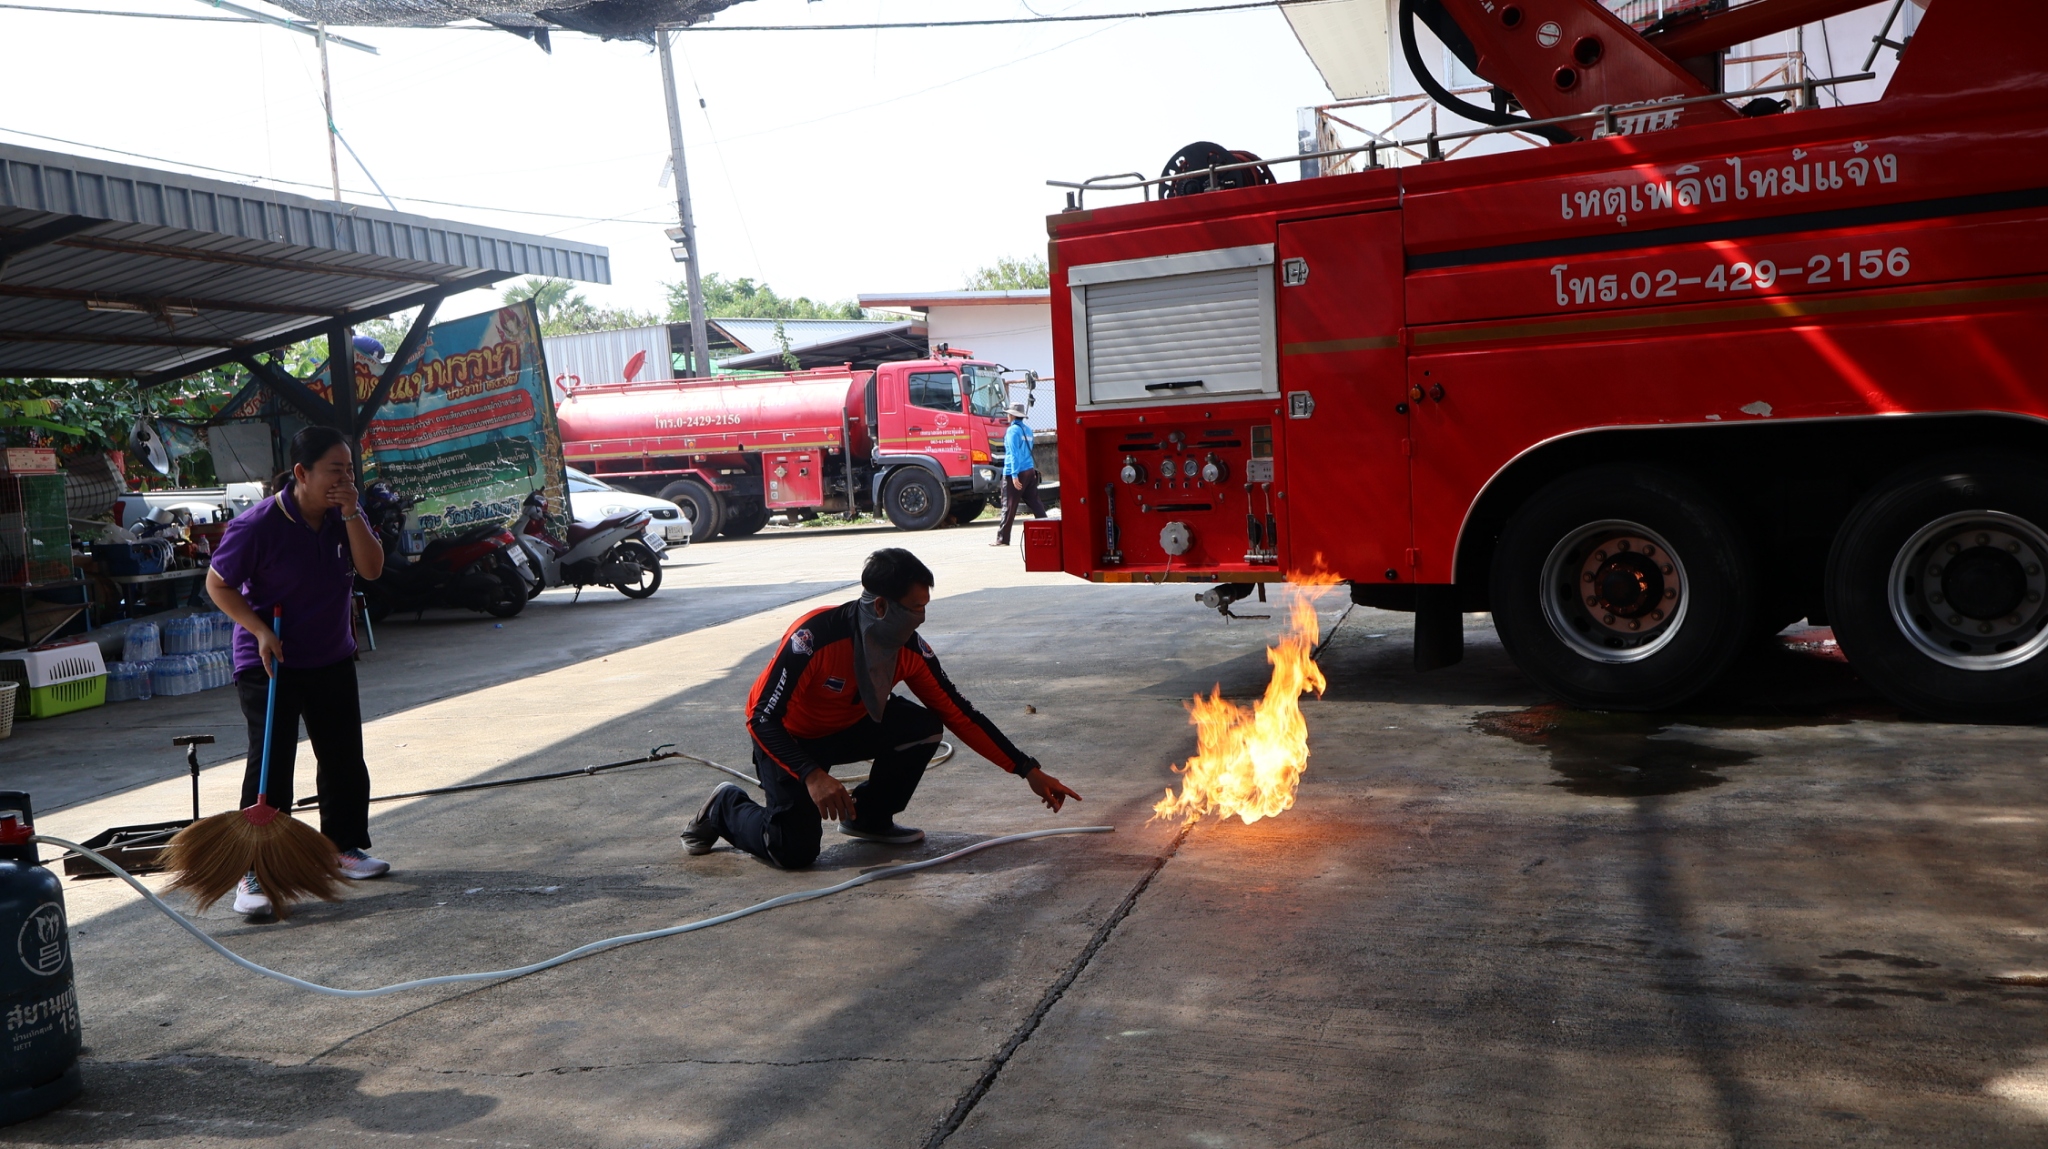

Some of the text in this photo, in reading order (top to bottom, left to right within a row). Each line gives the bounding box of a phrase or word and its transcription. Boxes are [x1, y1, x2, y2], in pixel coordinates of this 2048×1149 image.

[1561, 140, 1899, 227] เหตุเพลิงไหม้แจ้ง
[1551, 246, 1911, 307] โทร.02-429-2156
[654, 413, 741, 429] โทร.0-2429-2156
[763, 667, 788, 715] FIGHTER
